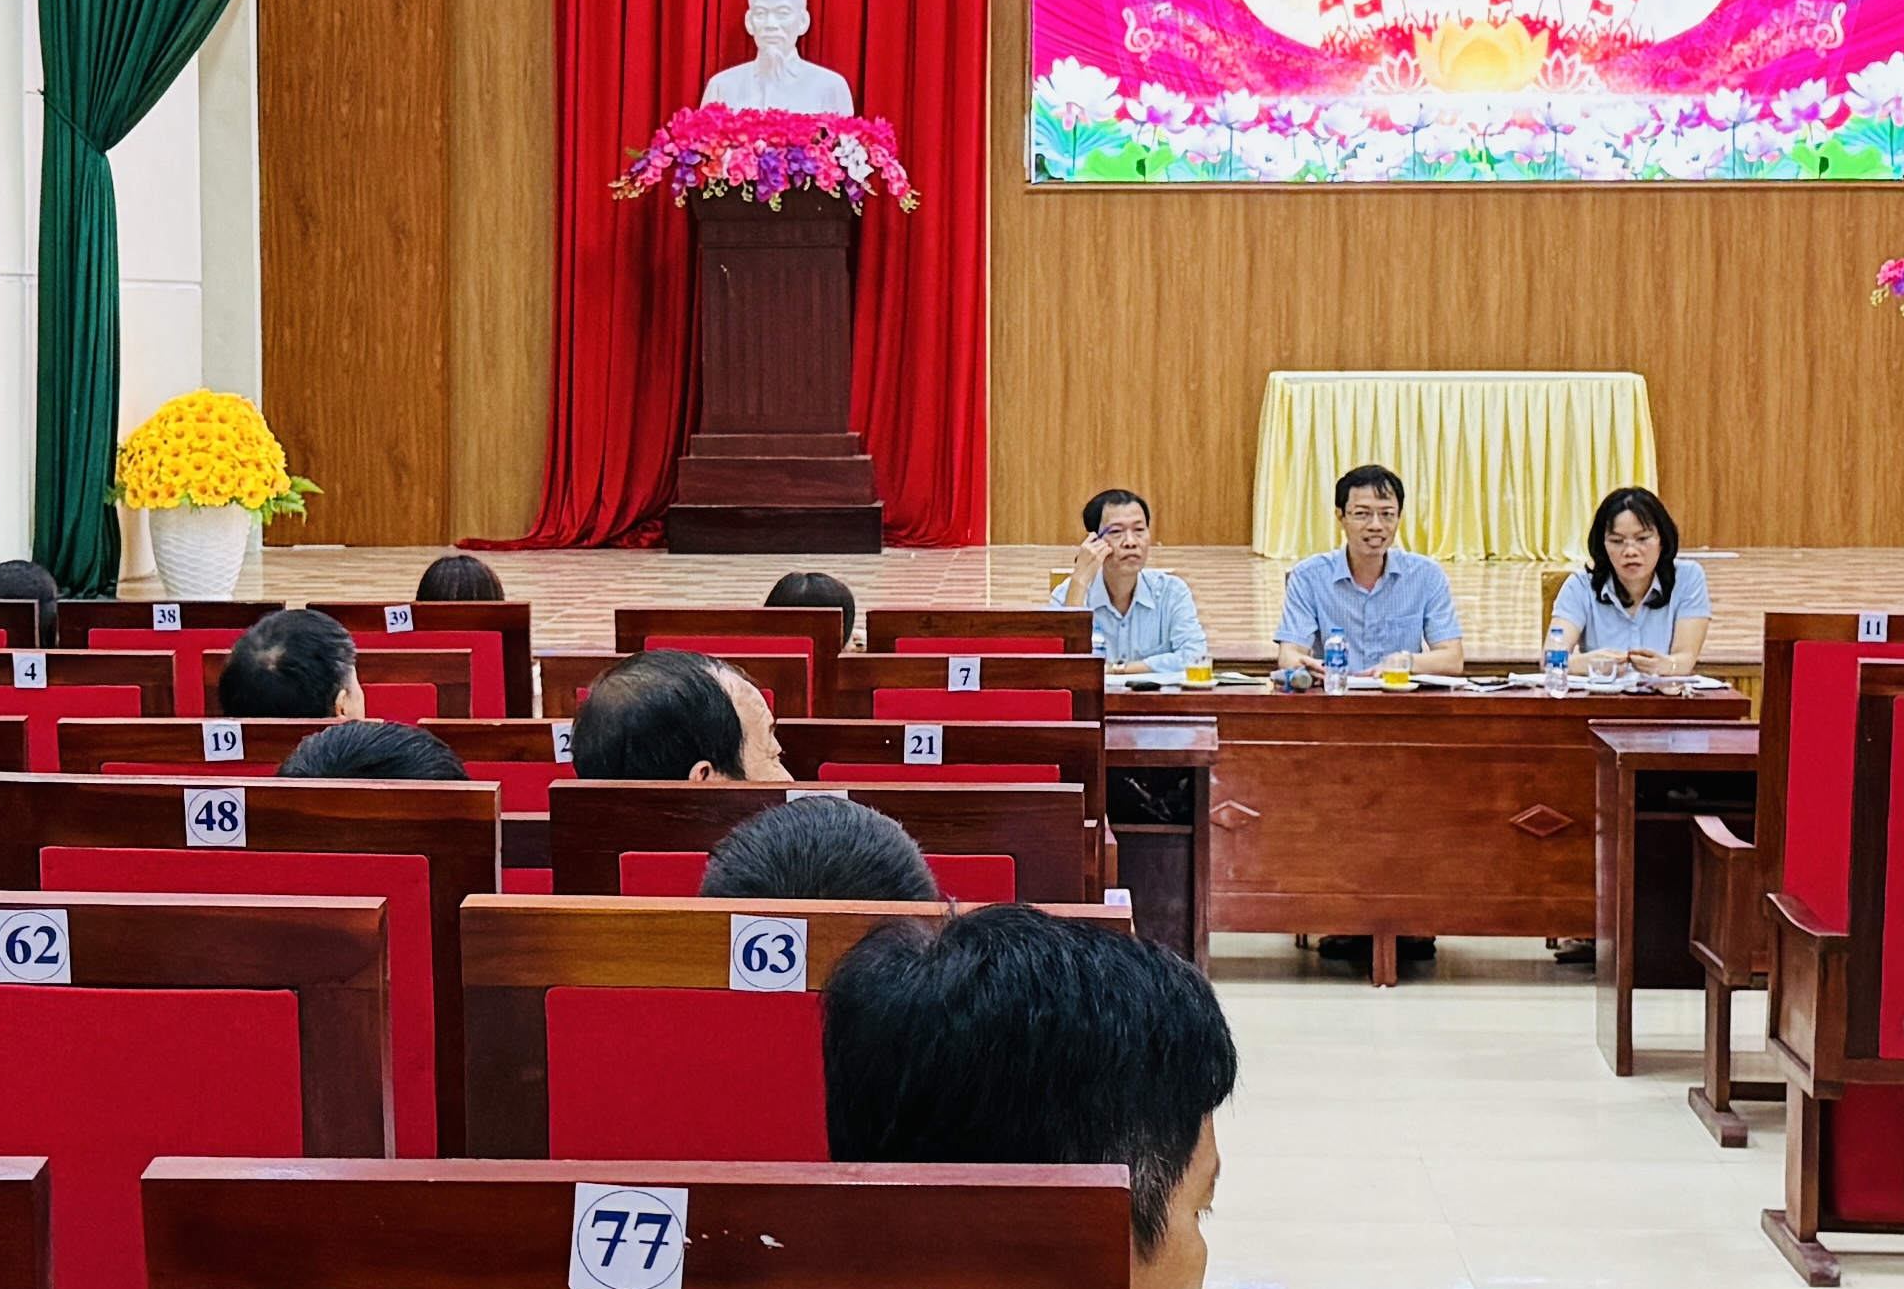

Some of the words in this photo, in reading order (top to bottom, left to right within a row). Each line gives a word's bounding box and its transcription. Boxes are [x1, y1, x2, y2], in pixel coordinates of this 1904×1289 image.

[158, 610, 177, 623] 38
[389, 611, 408, 627] 39
[1867, 621, 1880, 635] 11
[25, 663, 36, 680] 4
[960, 668, 970, 685] 7
[213, 732, 236, 751] 19
[911, 736, 934, 754] 21
[195, 801, 238, 831] 48
[6, 926, 59, 964] 62
[743, 933, 795, 973] 63
[592, 1210, 672, 1269] 77
